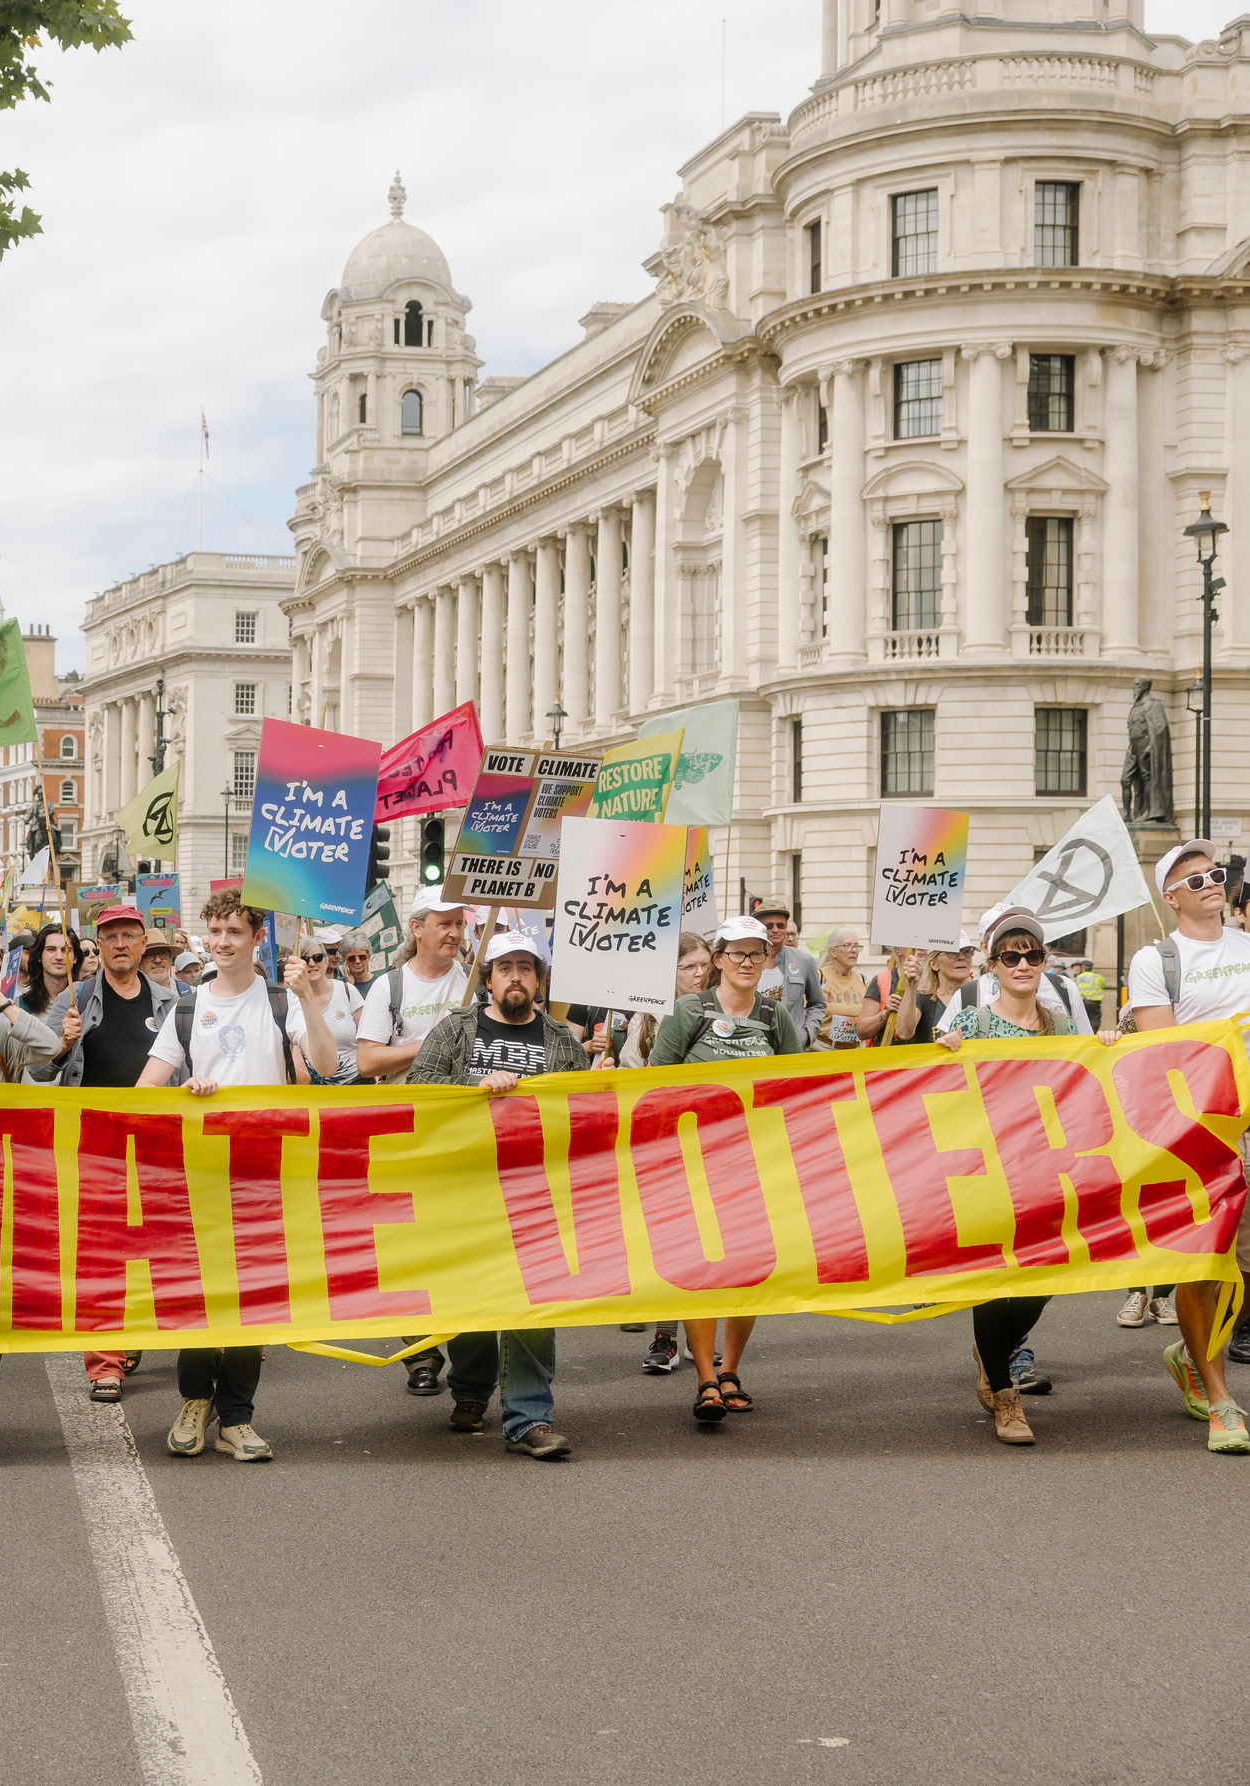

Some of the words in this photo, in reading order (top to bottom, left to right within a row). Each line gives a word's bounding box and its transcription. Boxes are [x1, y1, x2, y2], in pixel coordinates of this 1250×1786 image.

[487, 755, 526, 773] VOTE
[537, 759, 598, 779] CLIMATE
[598, 756, 664, 793] RESTORE
[284, 780, 325, 808] I'M
[331, 790, 348, 810] A
[553, 784, 584, 796] SUPPORT
[483, 801, 501, 811] I'M
[504, 802, 513, 811] A
[537, 795, 566, 807] CLIMATE
[601, 788, 660, 819] NATURE
[261, 803, 365, 840] CLIMATE
[471, 812, 520, 822] CLIMATE
[533, 807, 559, 819] VOTERS
[899, 848, 927, 866] I'M
[934, 852, 946, 866] A
[460, 857, 505, 875] THERE
[506, 860, 522, 876] IS
[533, 863, 555, 879] NO
[694, 861, 702, 873] A
[587, 873, 627, 898] I'M
[636, 878, 653, 898] A
[882, 868, 959, 887] CLIMATE
[470, 879, 524, 896] PLANET
[524, 882, 536, 897] B
[319, 902, 357, 915] GREENPEACE
[564, 899, 672, 928] CLIMATE
[628, 994, 667, 1006] GREENPEACE
[712, 1047, 768, 1057] VOLUNTEER
[487, 1039, 1249, 1305] VOTERS
